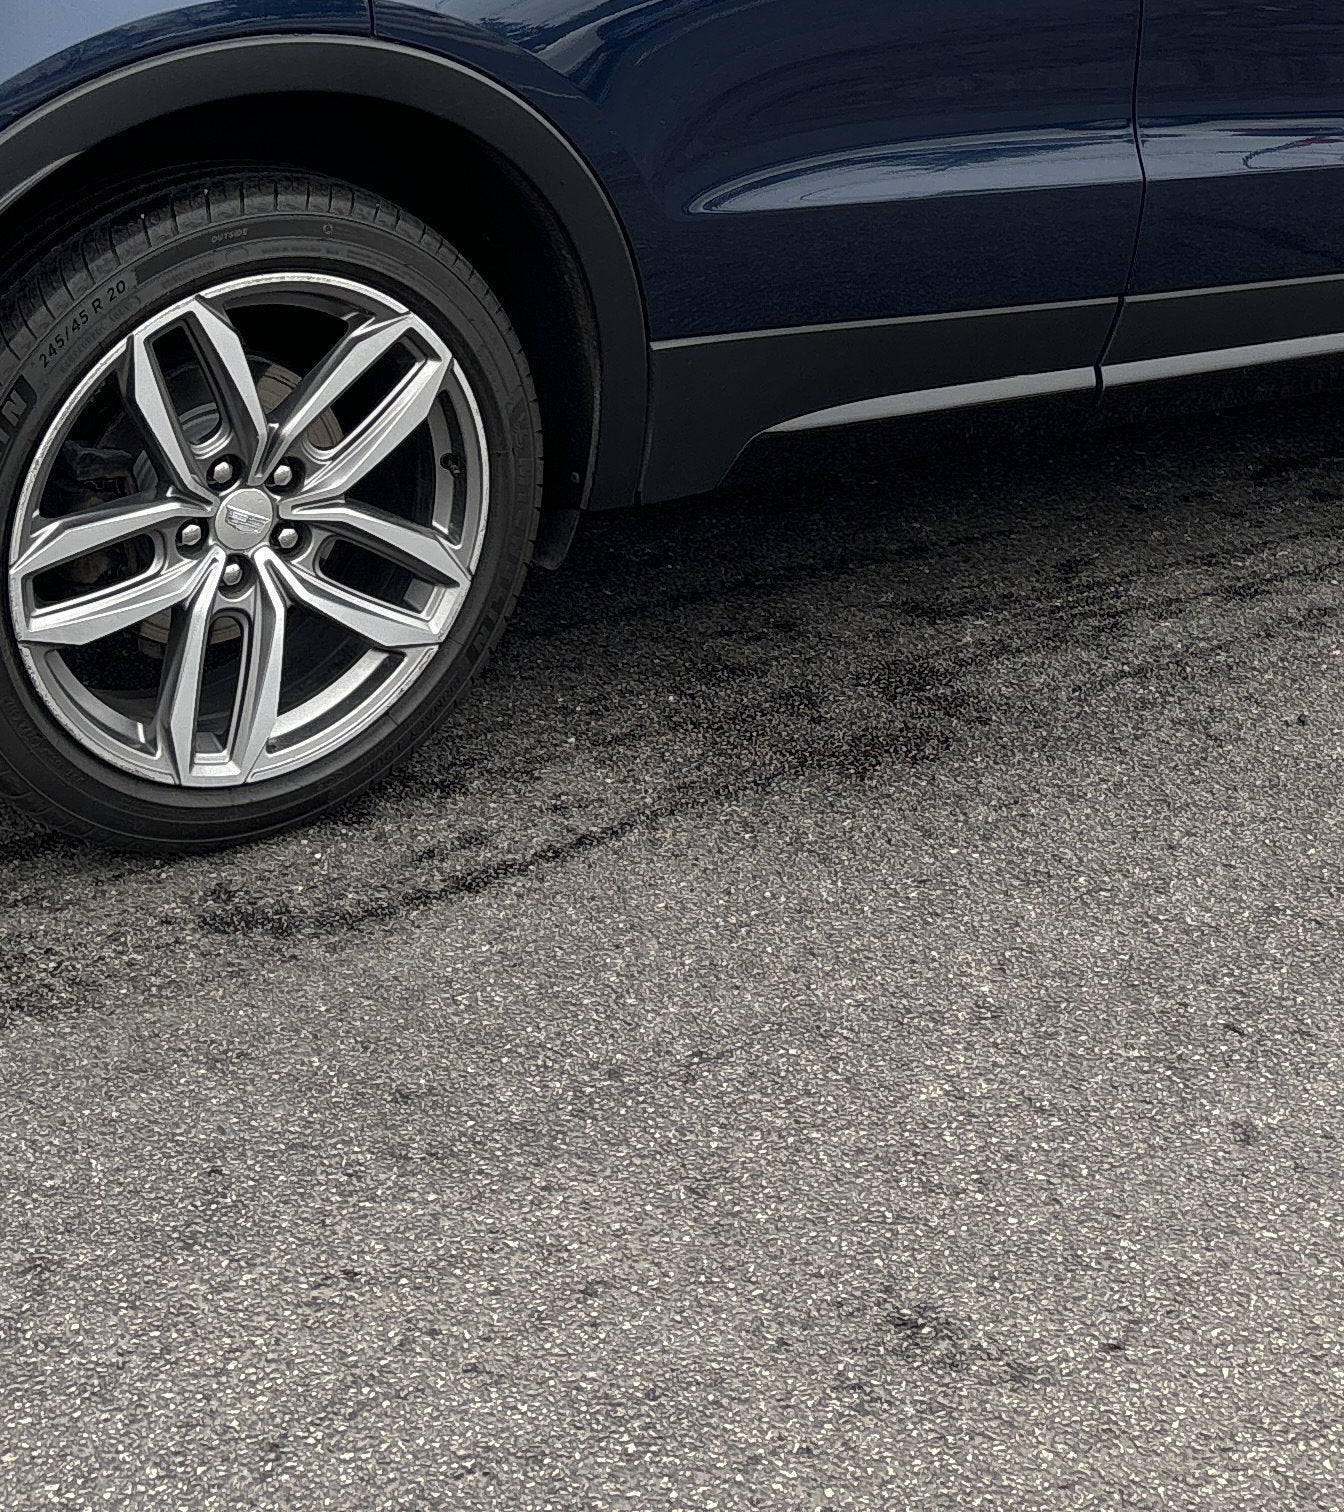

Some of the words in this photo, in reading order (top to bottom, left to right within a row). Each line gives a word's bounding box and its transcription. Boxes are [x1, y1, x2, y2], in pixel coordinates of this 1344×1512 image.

[211, 227, 249, 244] OUTSIDE
[39, 309, 89, 368] 245/45
[91, 297, 104, 314] R
[106, 279, 126, 303] 20
